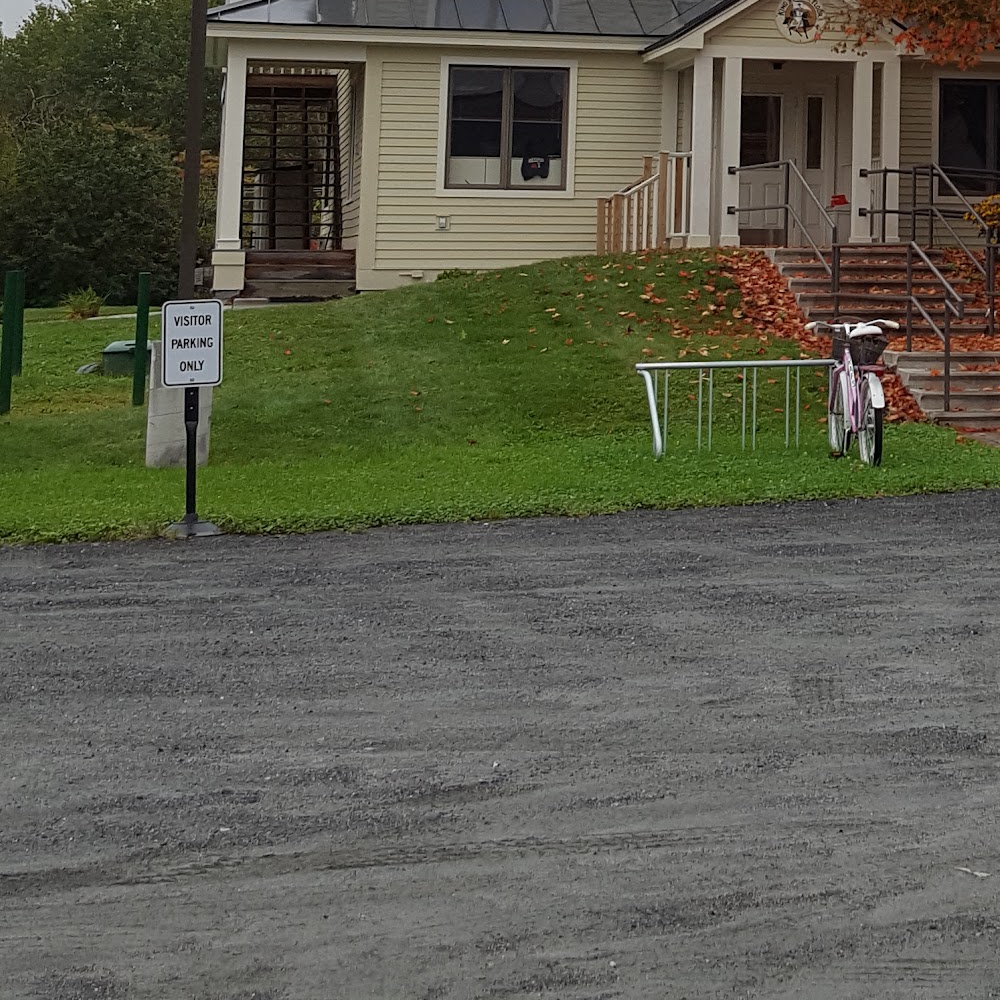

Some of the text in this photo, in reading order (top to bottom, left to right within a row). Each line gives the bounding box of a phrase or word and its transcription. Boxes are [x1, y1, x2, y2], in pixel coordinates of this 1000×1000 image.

[777, 1, 788, 16] KING
[174, 314, 212, 326] VISITOR
[171, 337, 214, 350] PARKING
[180, 360, 204, 372] ONLY
